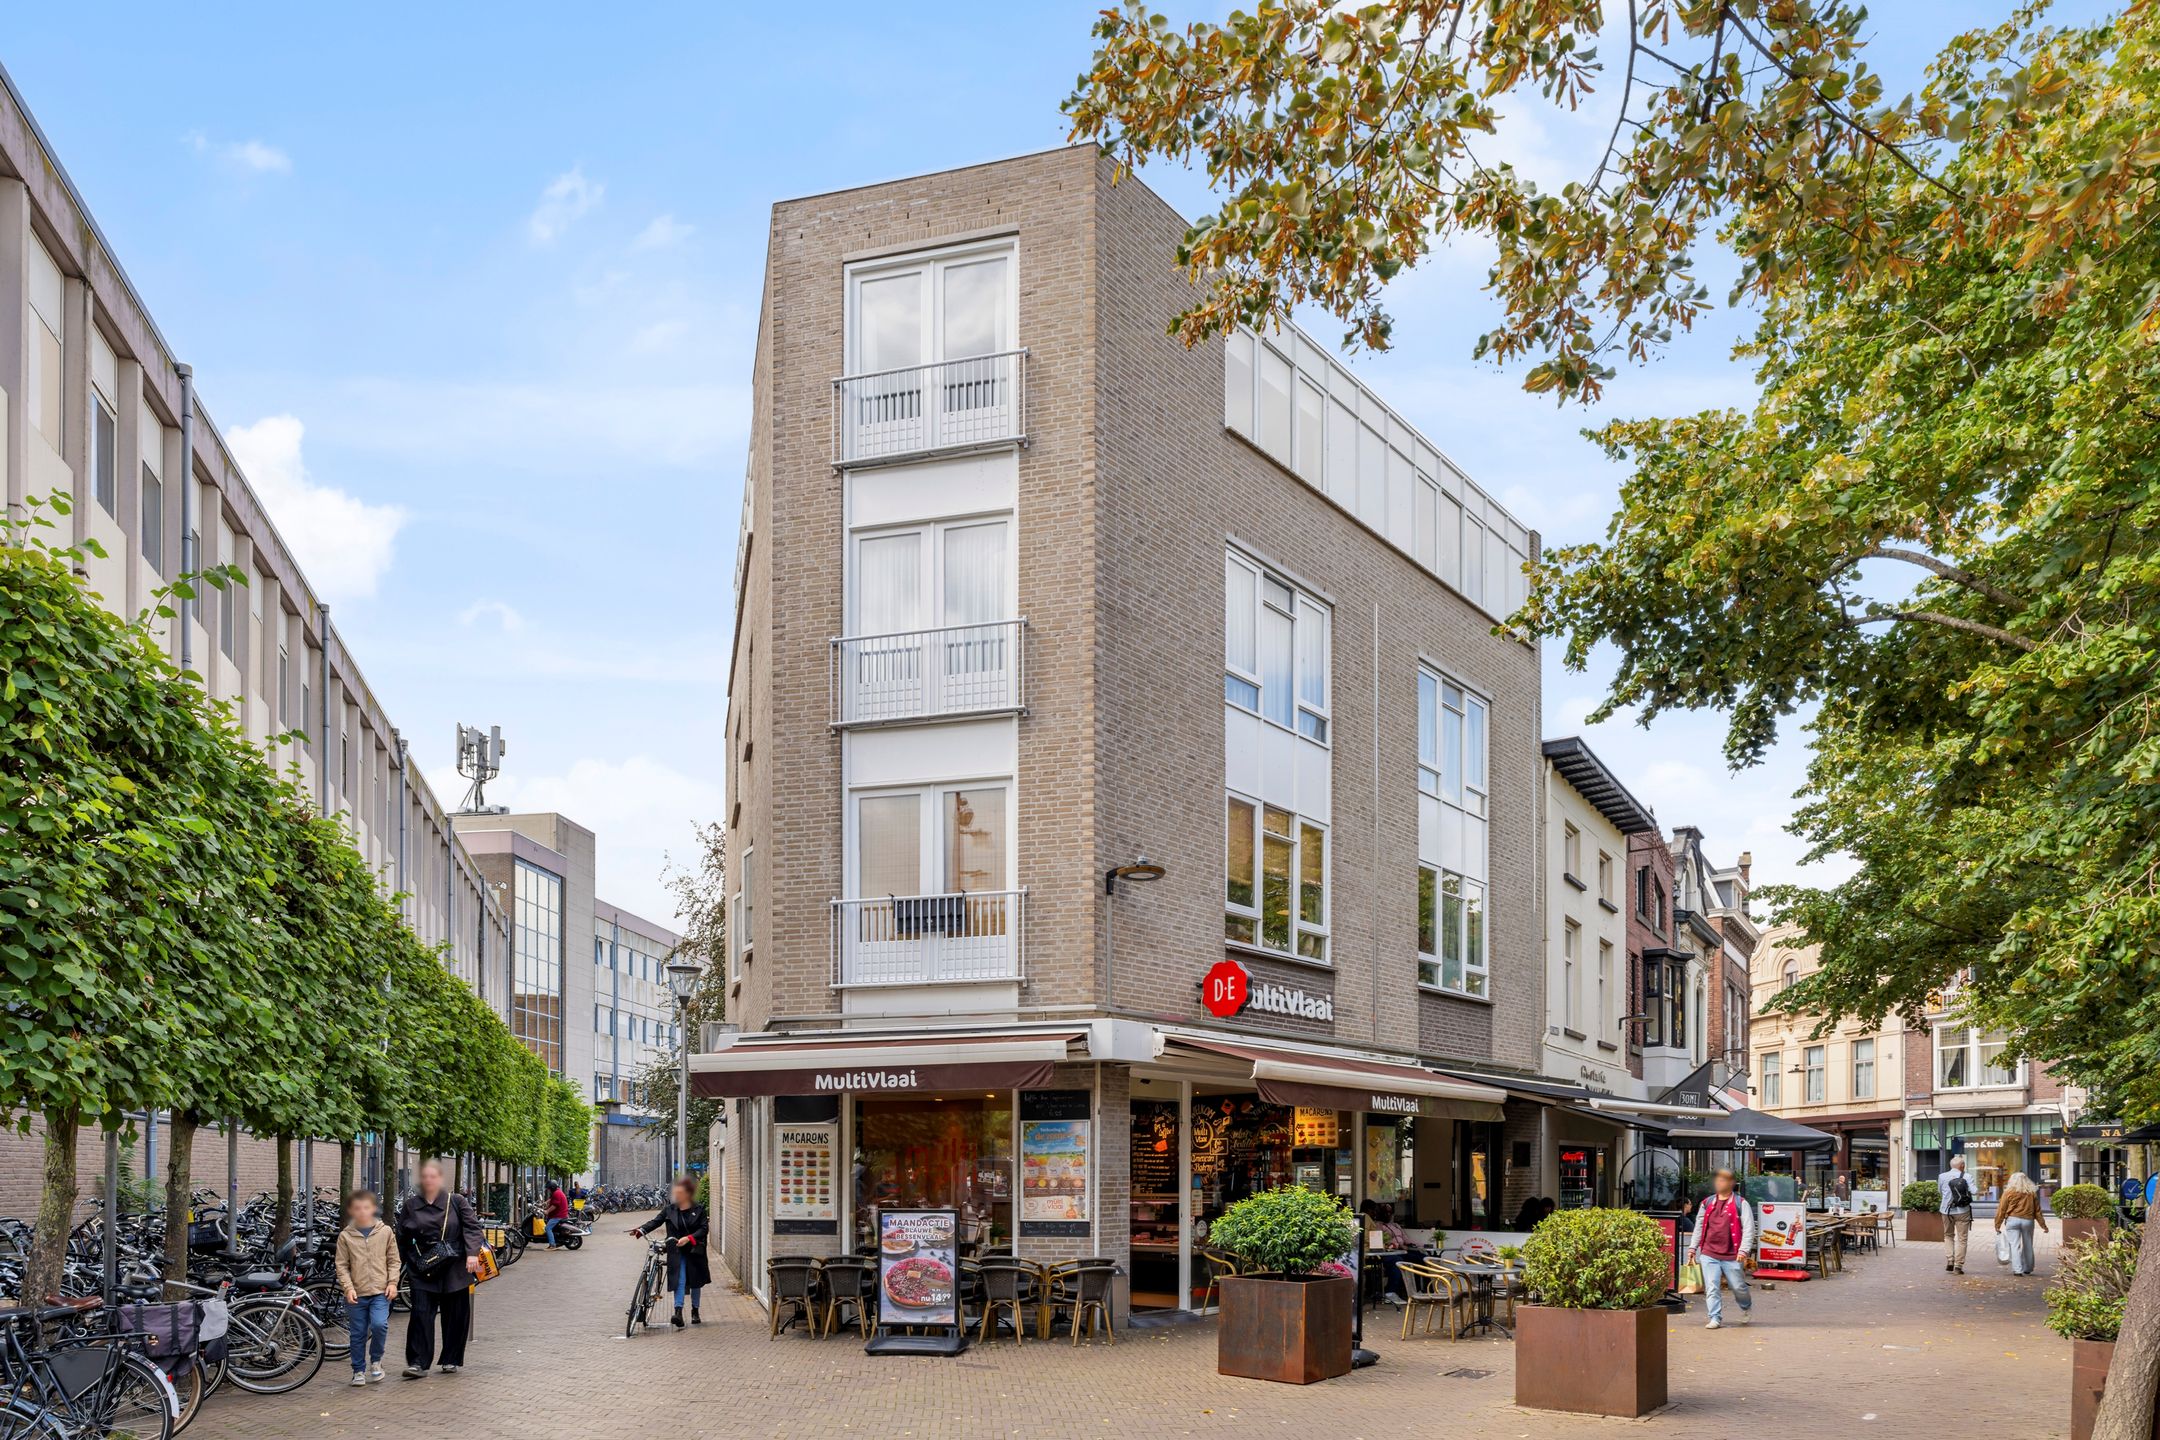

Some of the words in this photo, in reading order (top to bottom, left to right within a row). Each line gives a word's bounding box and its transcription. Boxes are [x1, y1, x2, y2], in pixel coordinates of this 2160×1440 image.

[1247, 983, 1333, 1021] ultiVlaai
[815, 1069, 918, 1090] MultiVlaai
[1372, 1096, 1419, 1112] MultiVlaai
[782, 1132, 829, 1144] MACARONS
[889, 1219, 949, 1227] MAANDACTIE
